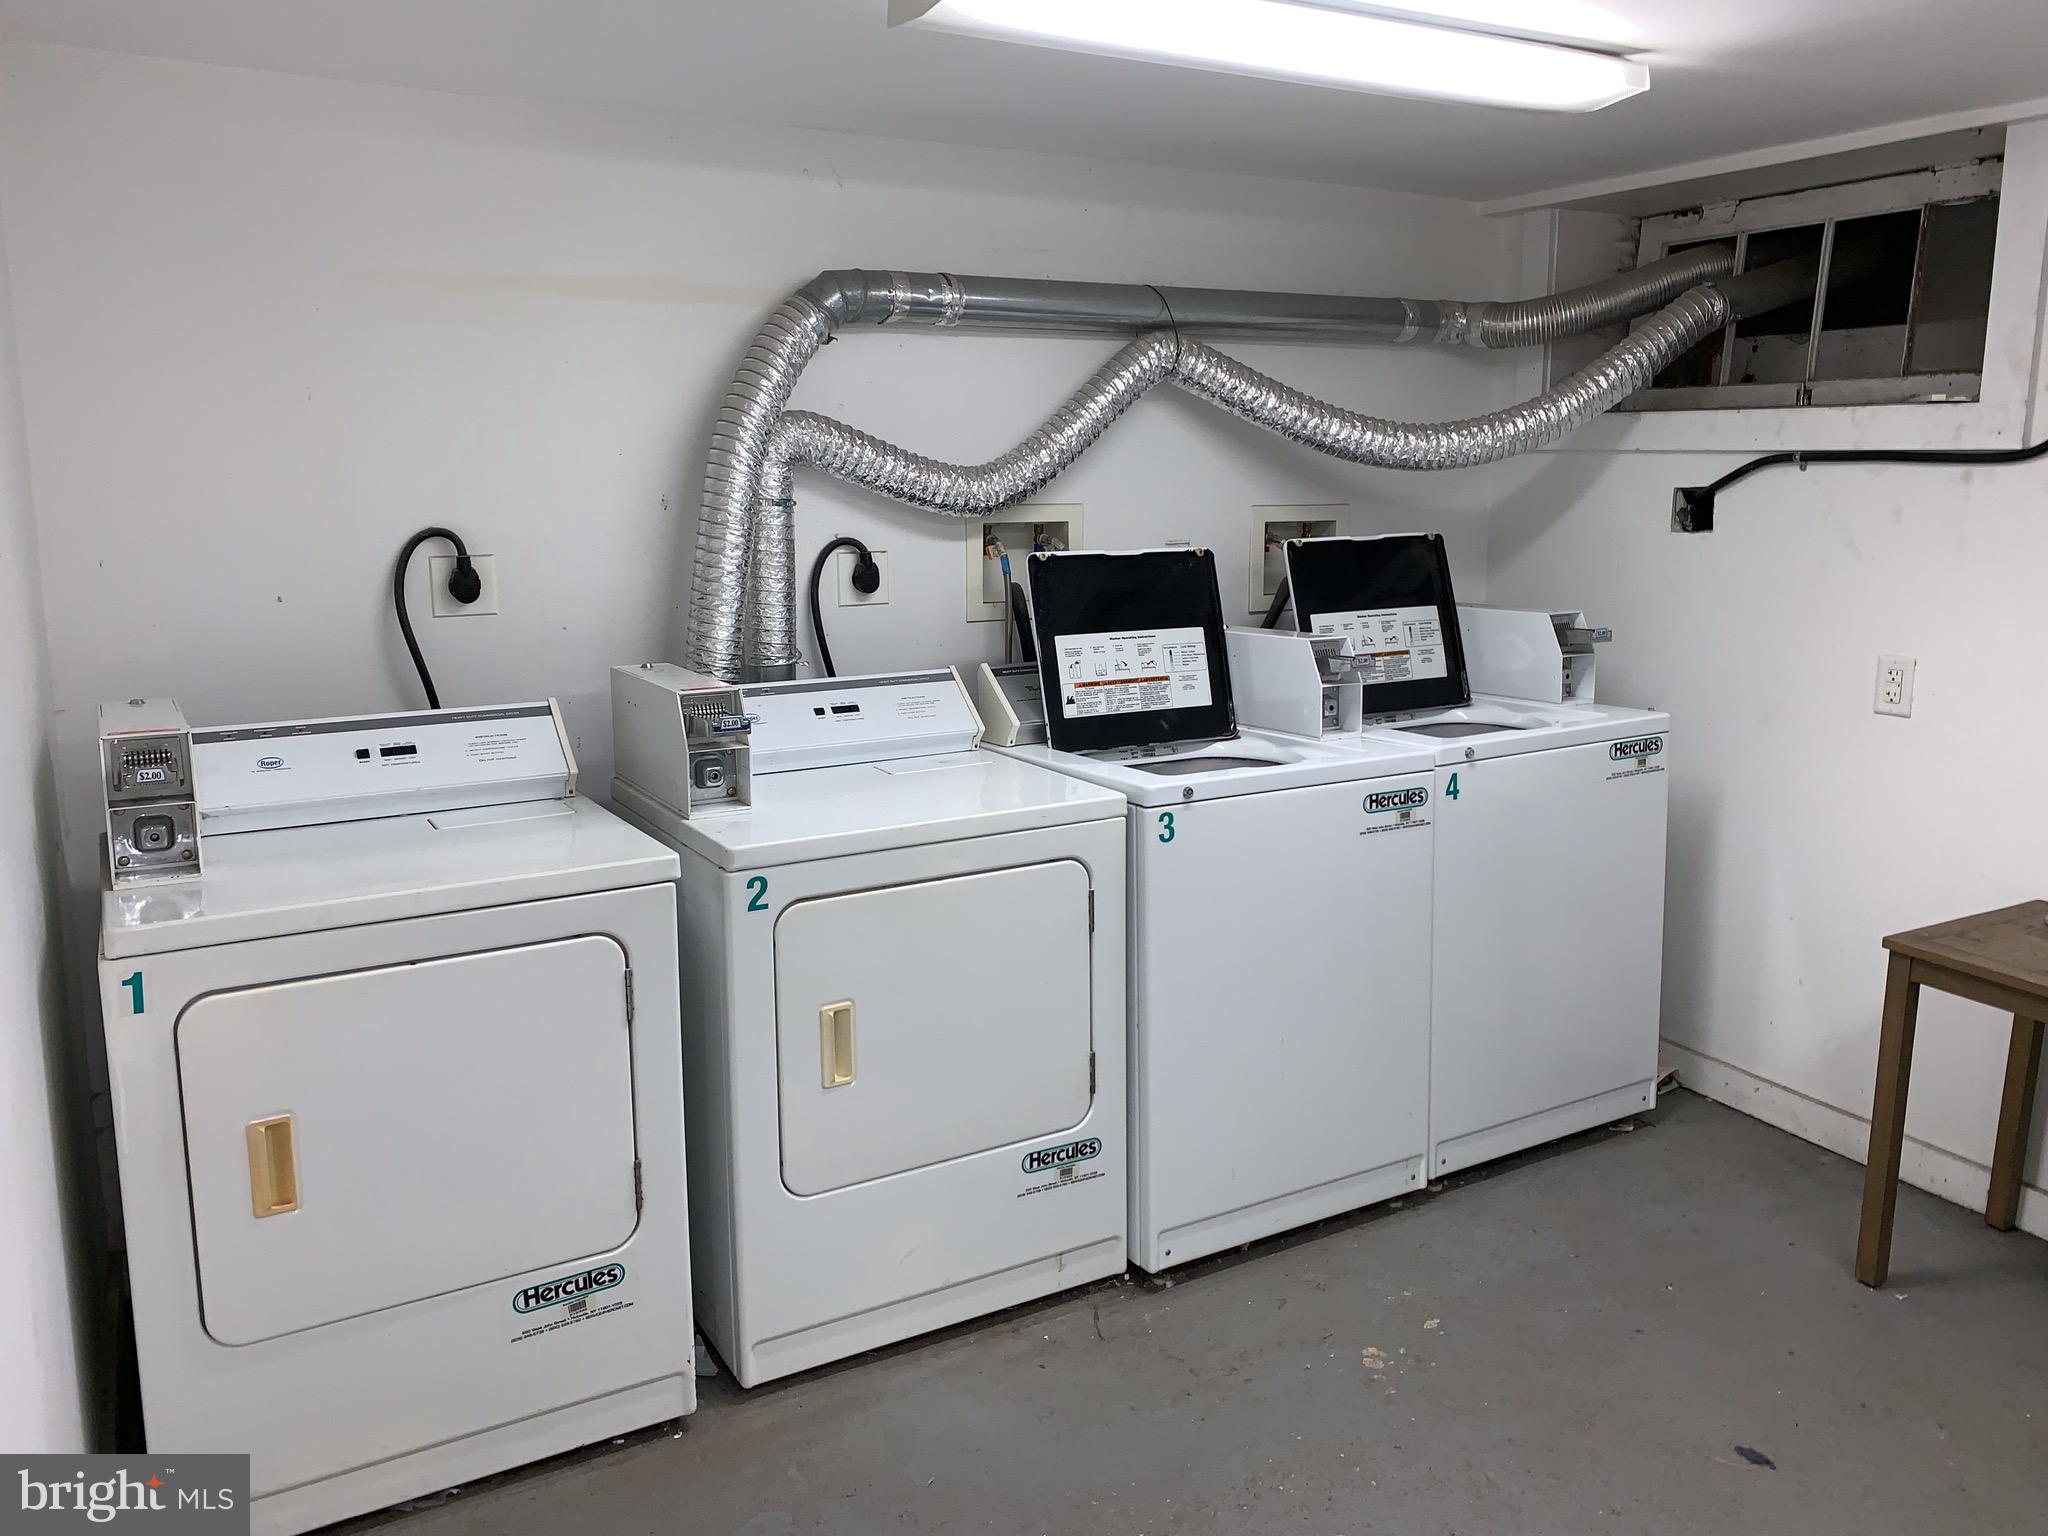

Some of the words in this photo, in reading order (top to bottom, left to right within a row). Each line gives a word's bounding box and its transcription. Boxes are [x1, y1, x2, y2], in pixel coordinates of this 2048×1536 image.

[722, 719, 739, 728] $2.00
[1614, 739, 1660, 757] Hercules
[139, 770, 162, 780] $2.00
[260, 758, 281, 768] Roper
[1369, 789, 1424, 809] Hercules
[1446, 772, 1460, 800] 4
[1159, 811, 1175, 843] 3
[747, 876, 769, 912] 2
[122, 971, 144, 1014] 1
[1029, 1141, 1097, 1170] Hercules
[523, 1268, 618, 1309] Hercules
